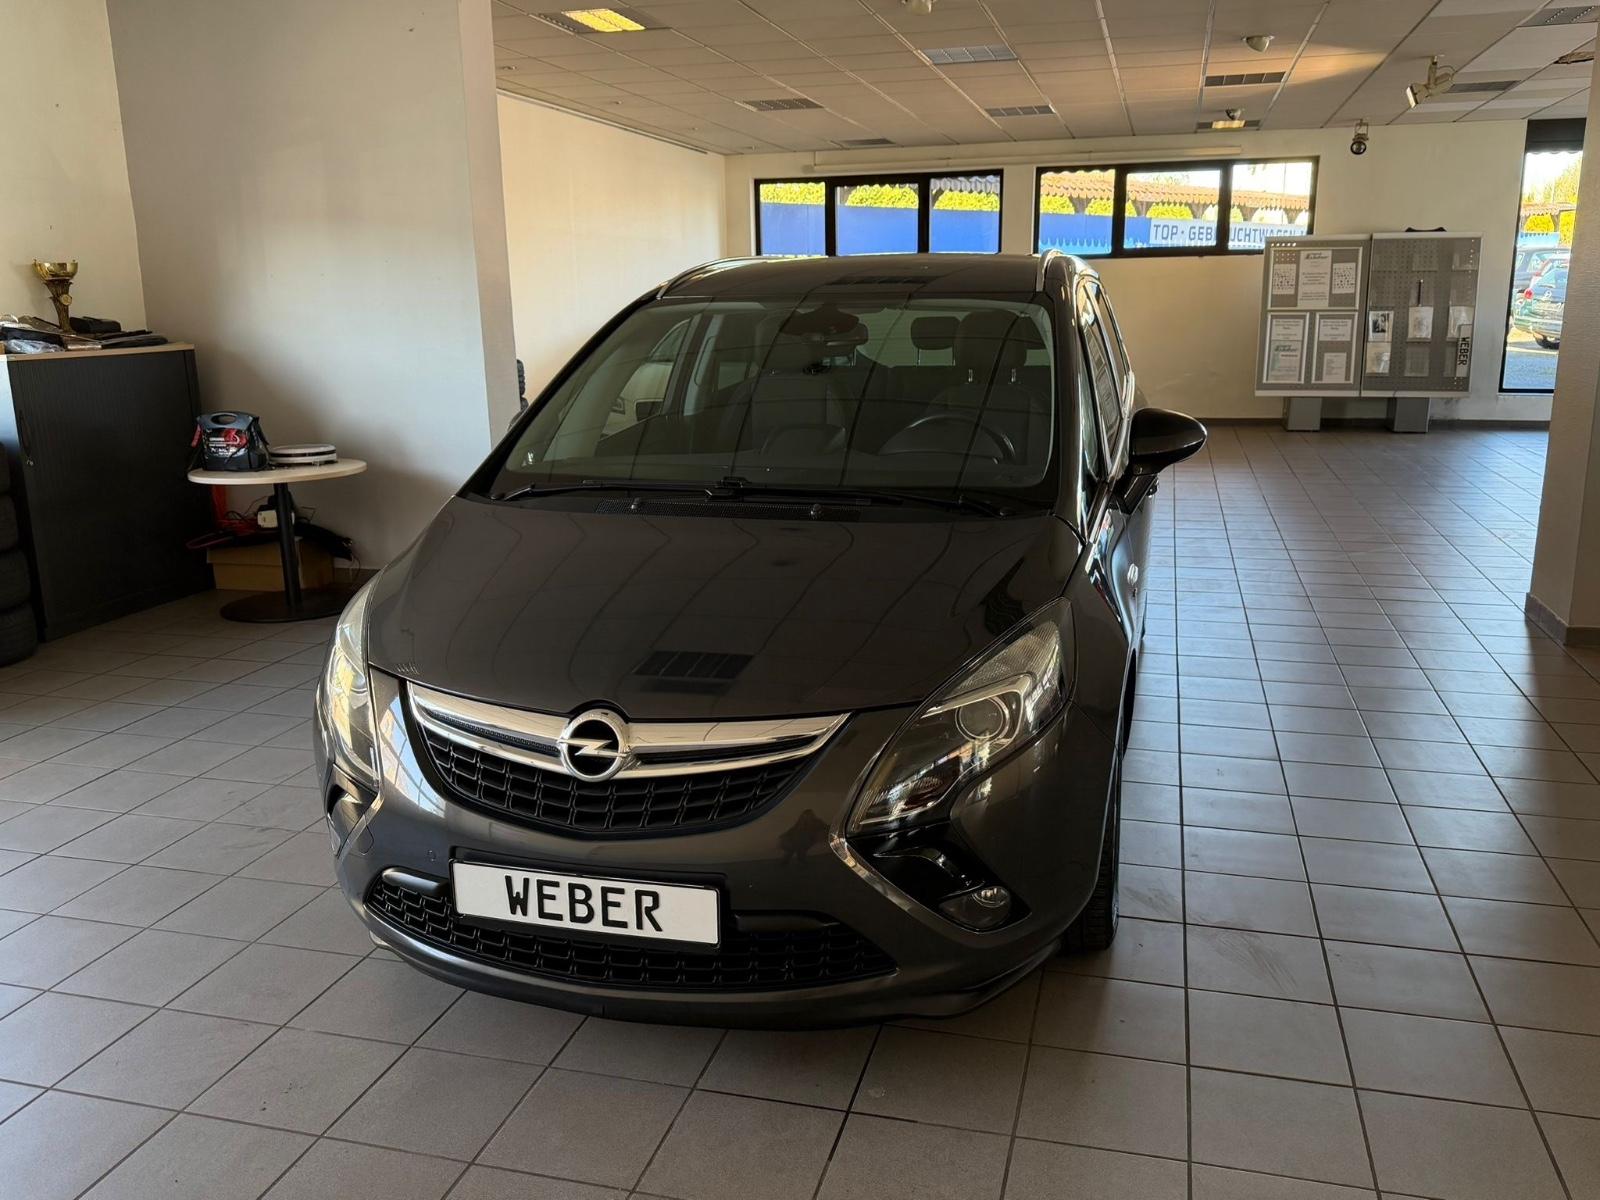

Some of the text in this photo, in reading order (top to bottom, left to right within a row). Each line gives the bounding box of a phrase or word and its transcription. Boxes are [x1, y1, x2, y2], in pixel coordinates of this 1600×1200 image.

[1153, 224, 1178, 241] TOP
[1457, 336, 1470, 366] WEBER
[504, 875, 663, 932] WEBER
